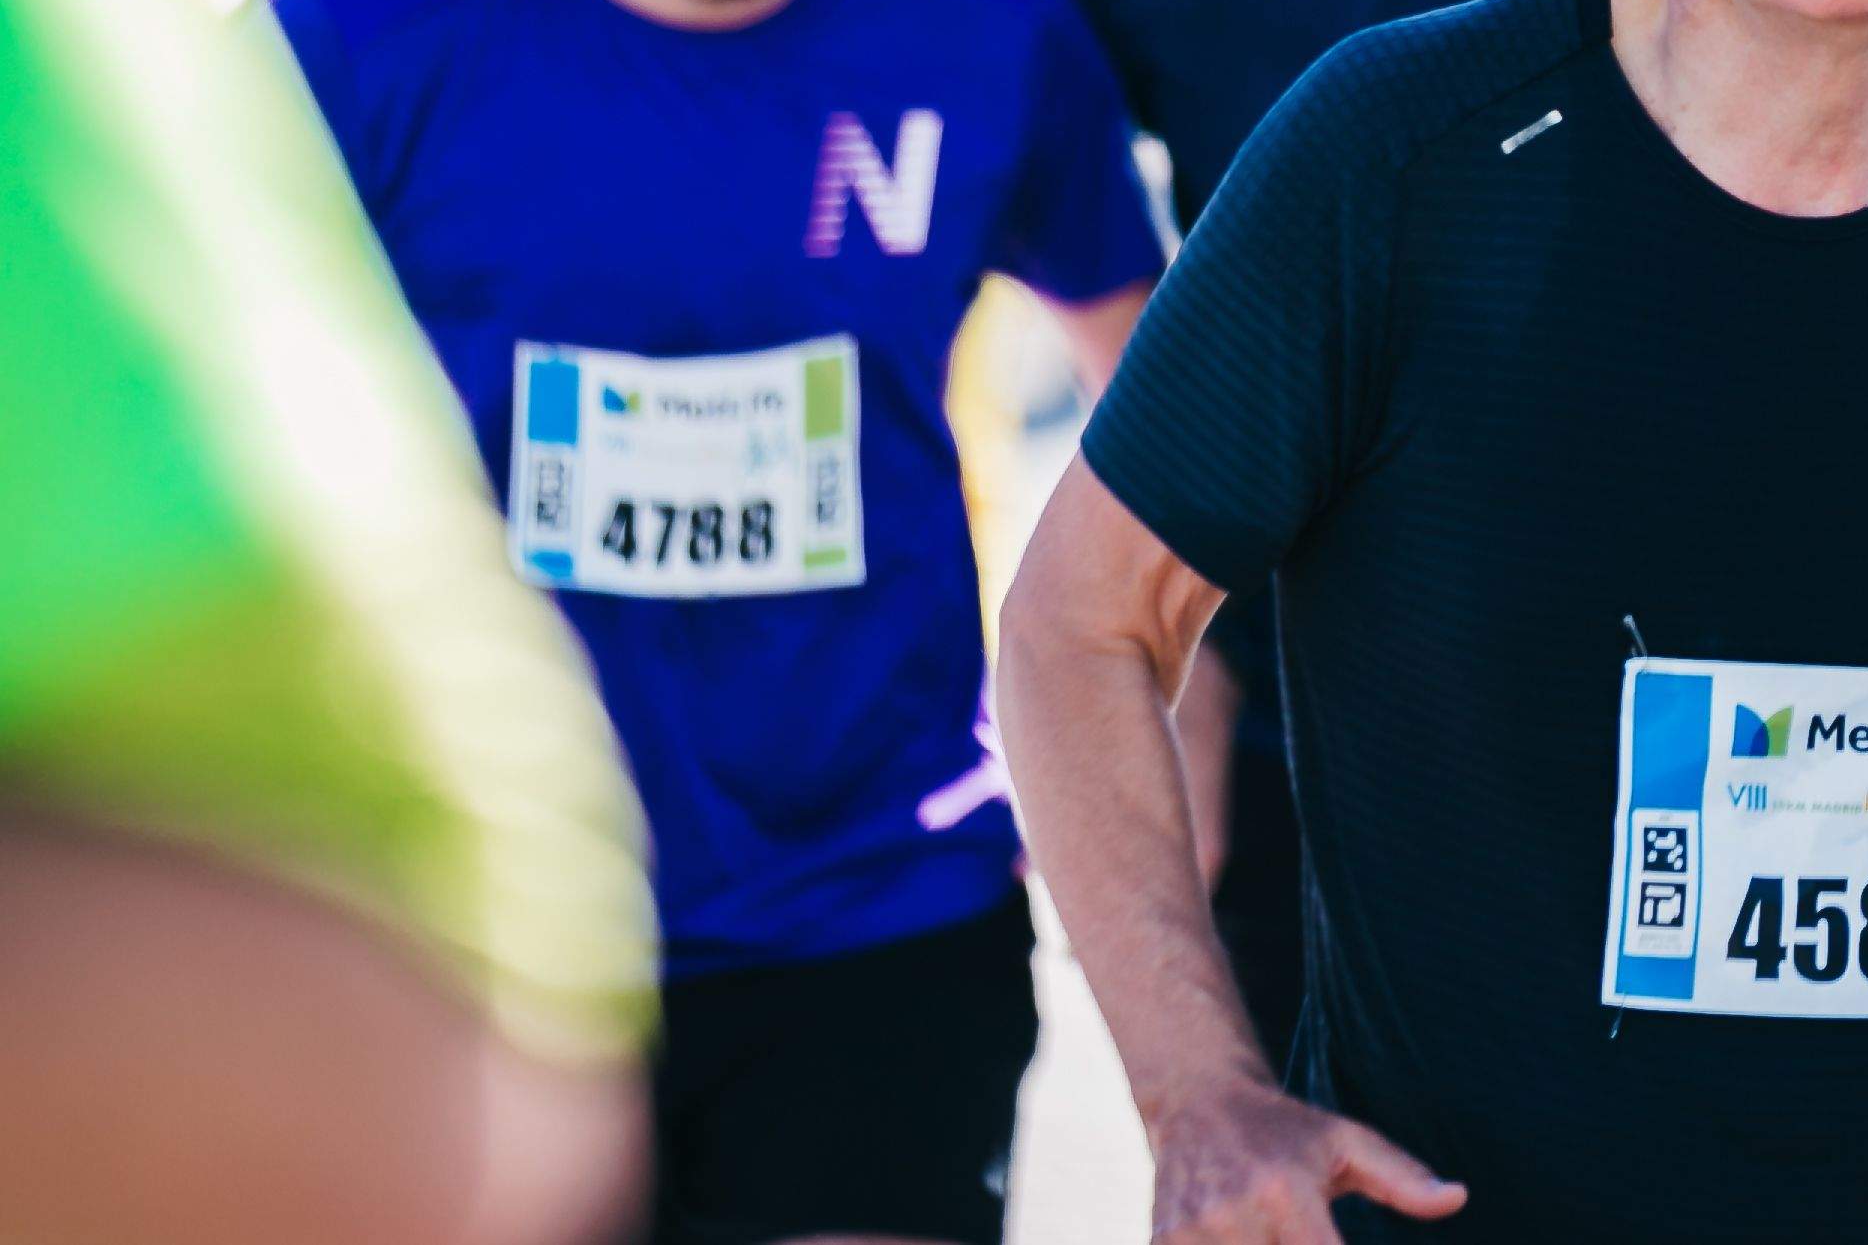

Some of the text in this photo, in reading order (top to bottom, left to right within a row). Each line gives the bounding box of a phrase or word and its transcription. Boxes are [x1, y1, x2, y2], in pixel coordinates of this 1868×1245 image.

[802, 108, 944, 258] N
[600, 498, 774, 570] 4788
[1727, 783, 1768, 811] VIII
